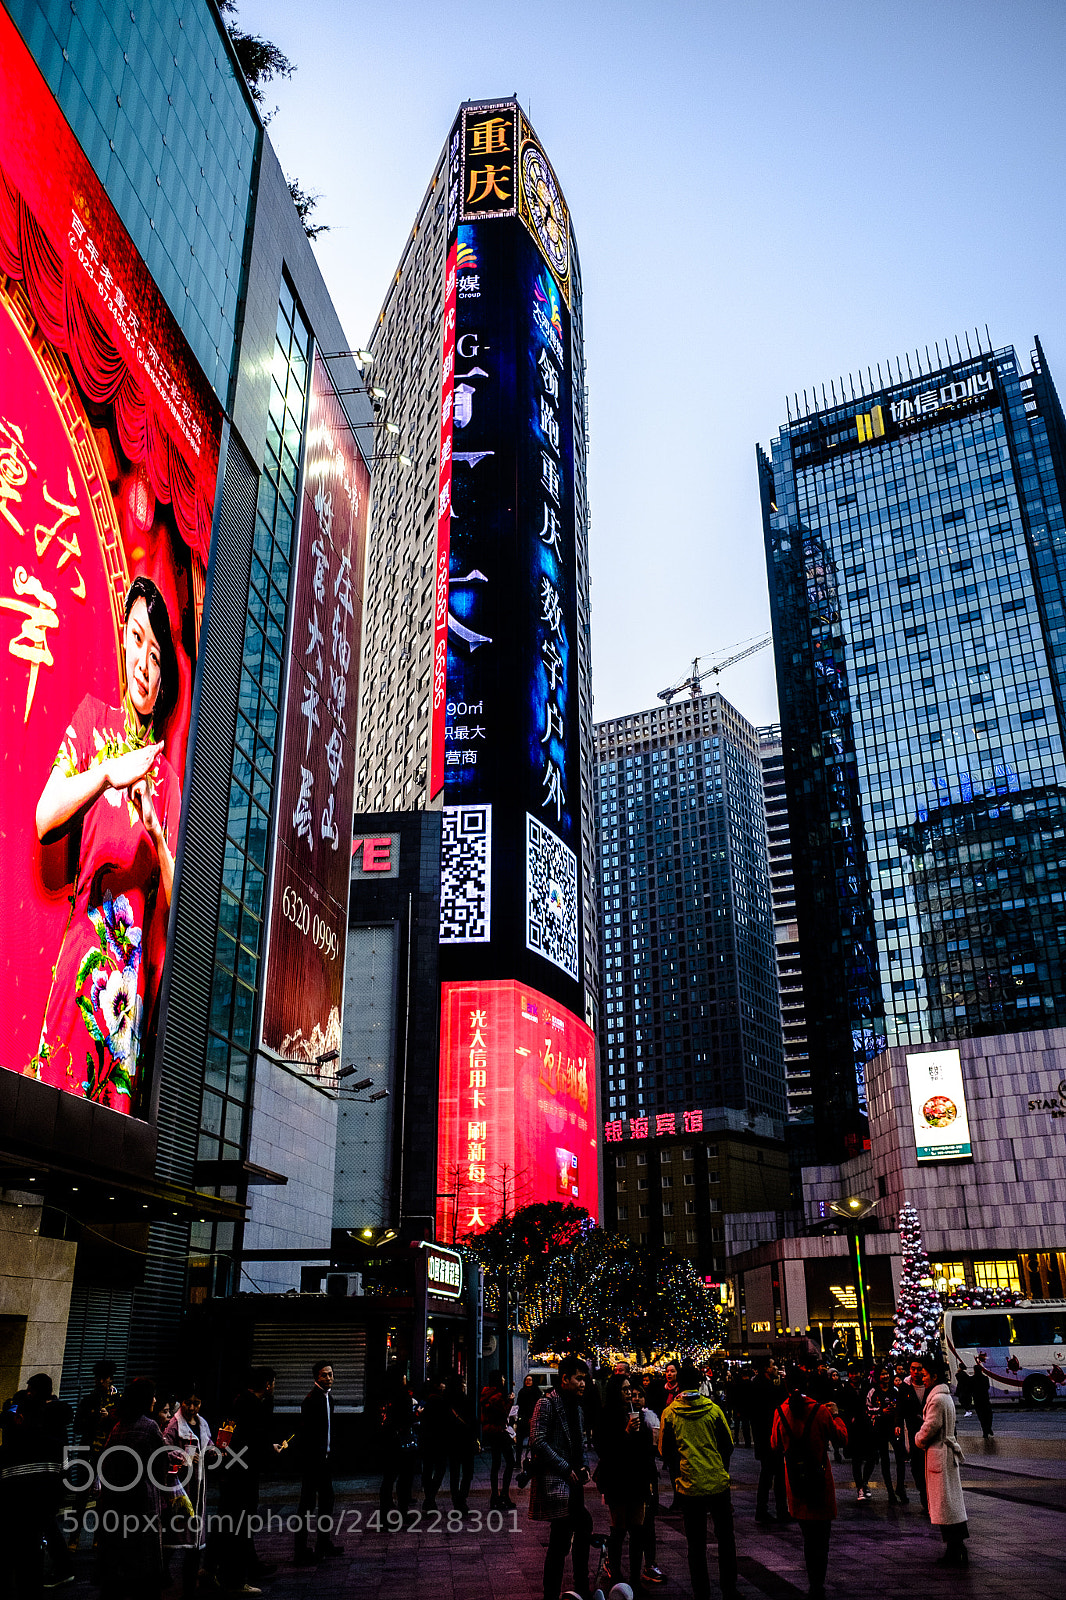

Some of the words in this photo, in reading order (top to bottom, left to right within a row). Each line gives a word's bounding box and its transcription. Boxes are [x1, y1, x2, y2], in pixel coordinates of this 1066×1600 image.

[465, 117, 513, 205] 重庆
[888, 371, 994, 423] 协信中心
[445, 748, 478, 765] 营商
[282, 885, 311, 936] 6320
[468, 1009, 487, 1109] 光大信用卡
[467, 1120, 487, 1227] 刷新每一天
